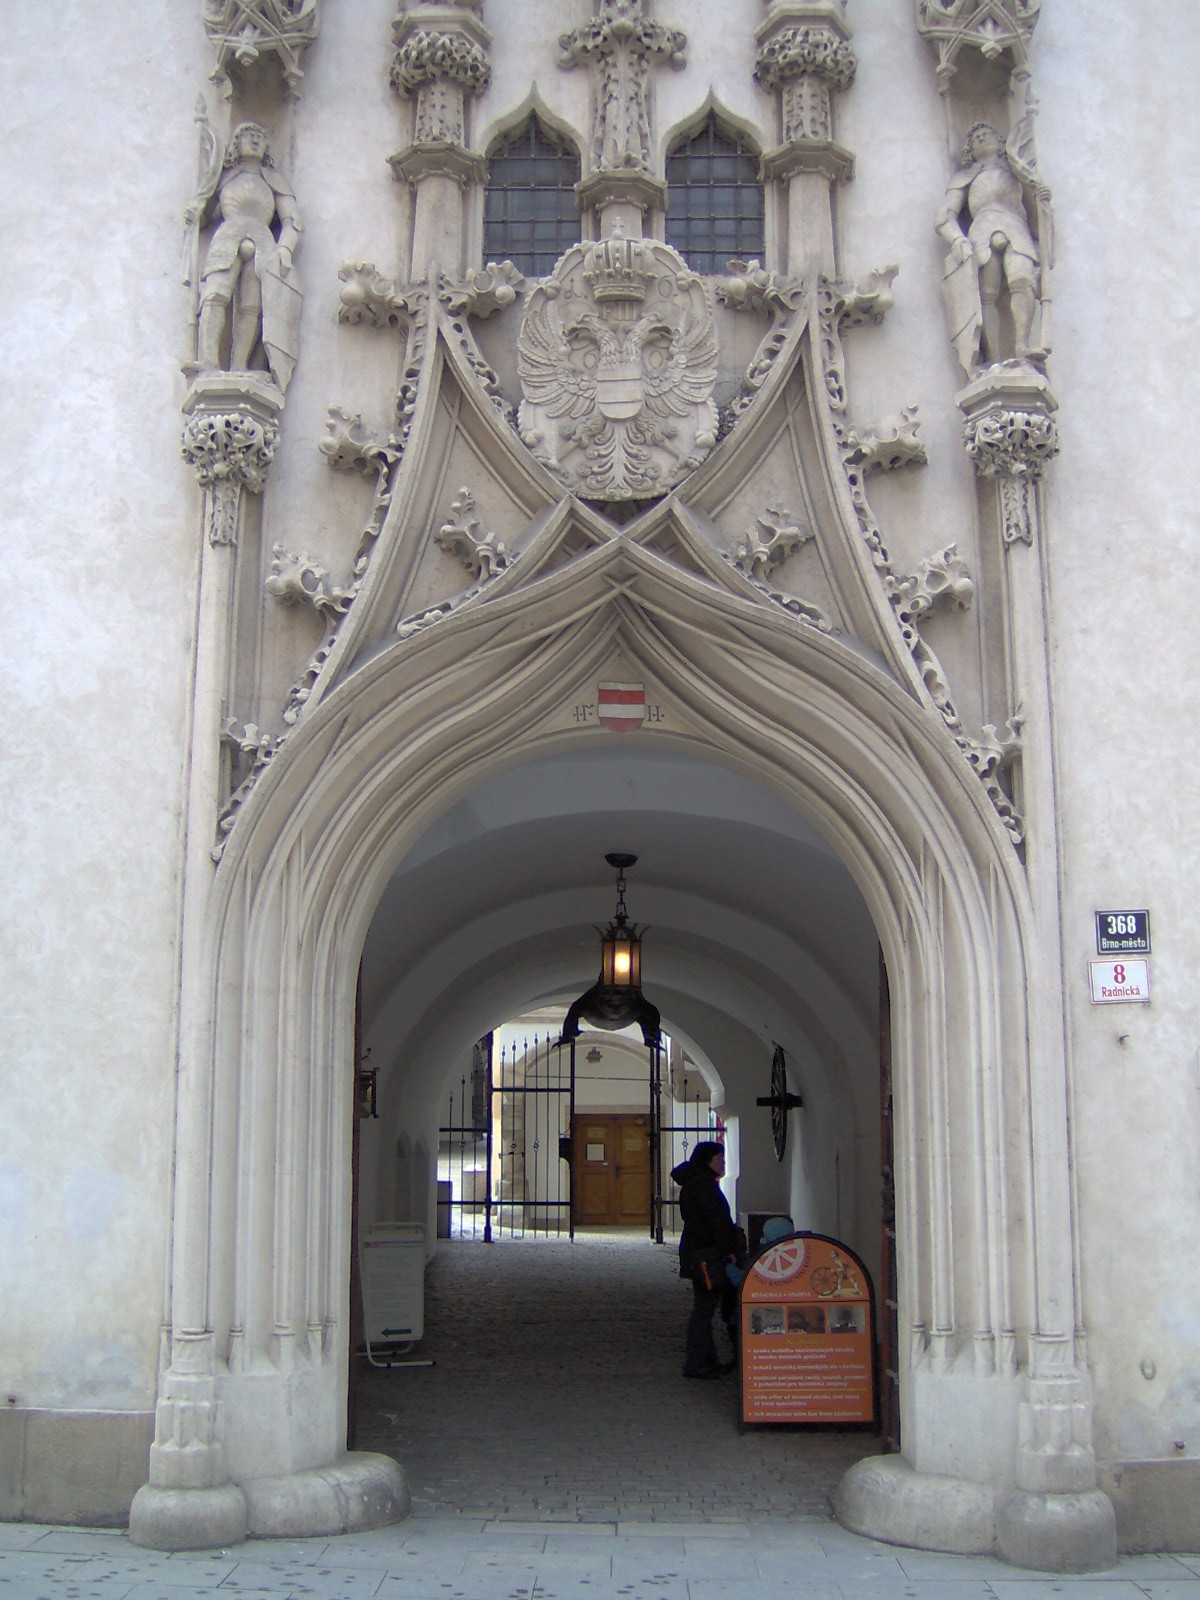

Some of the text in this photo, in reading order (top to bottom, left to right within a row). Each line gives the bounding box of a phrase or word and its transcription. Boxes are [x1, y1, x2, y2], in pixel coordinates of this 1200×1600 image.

[1107, 916, 1137, 935] 368
[1102, 937, 1146, 949] Brno-město
[1113, 964, 1126, 984] 8
[1102, 986, 1140, 997] Radnická
